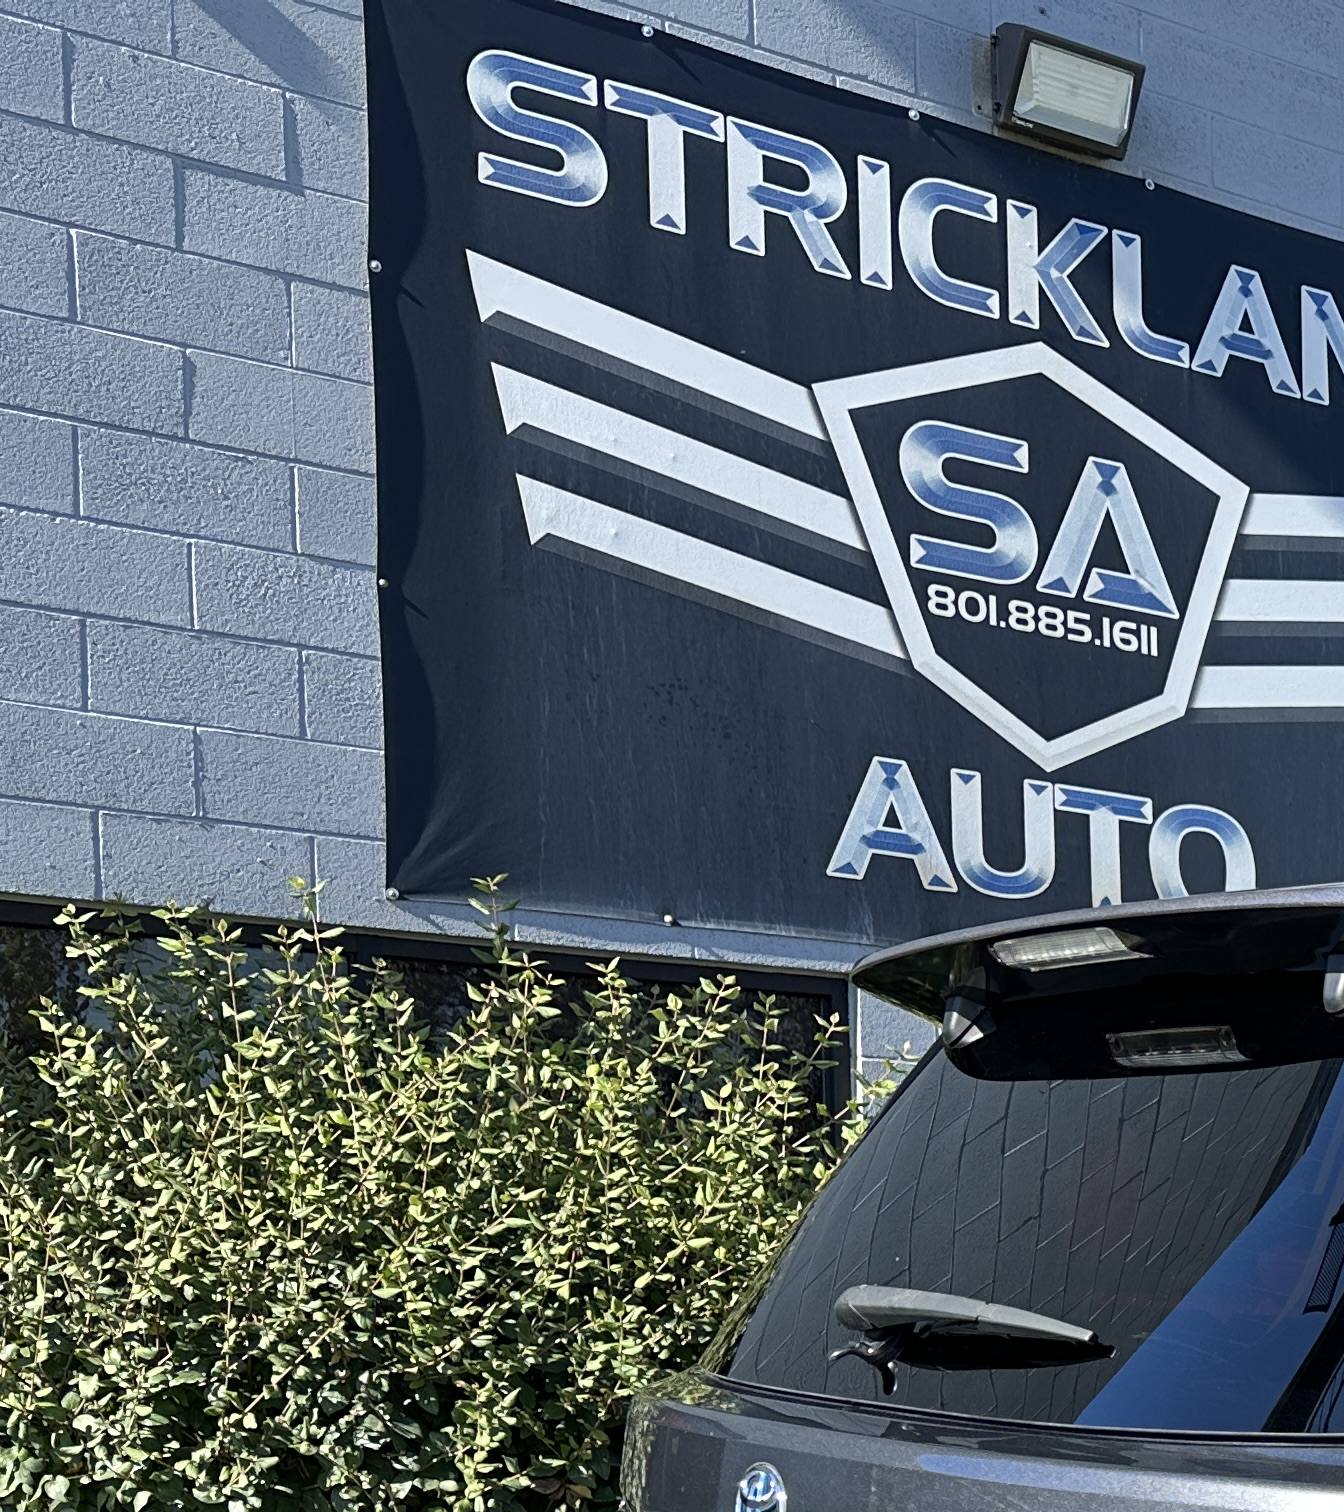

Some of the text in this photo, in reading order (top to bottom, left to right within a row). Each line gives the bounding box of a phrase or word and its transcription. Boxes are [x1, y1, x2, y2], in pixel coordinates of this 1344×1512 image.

[898, 420, 1181, 620] SA
[926, 582, 1159, 657] 801.885.1611
[825, 755, 1257, 908] AUTO
